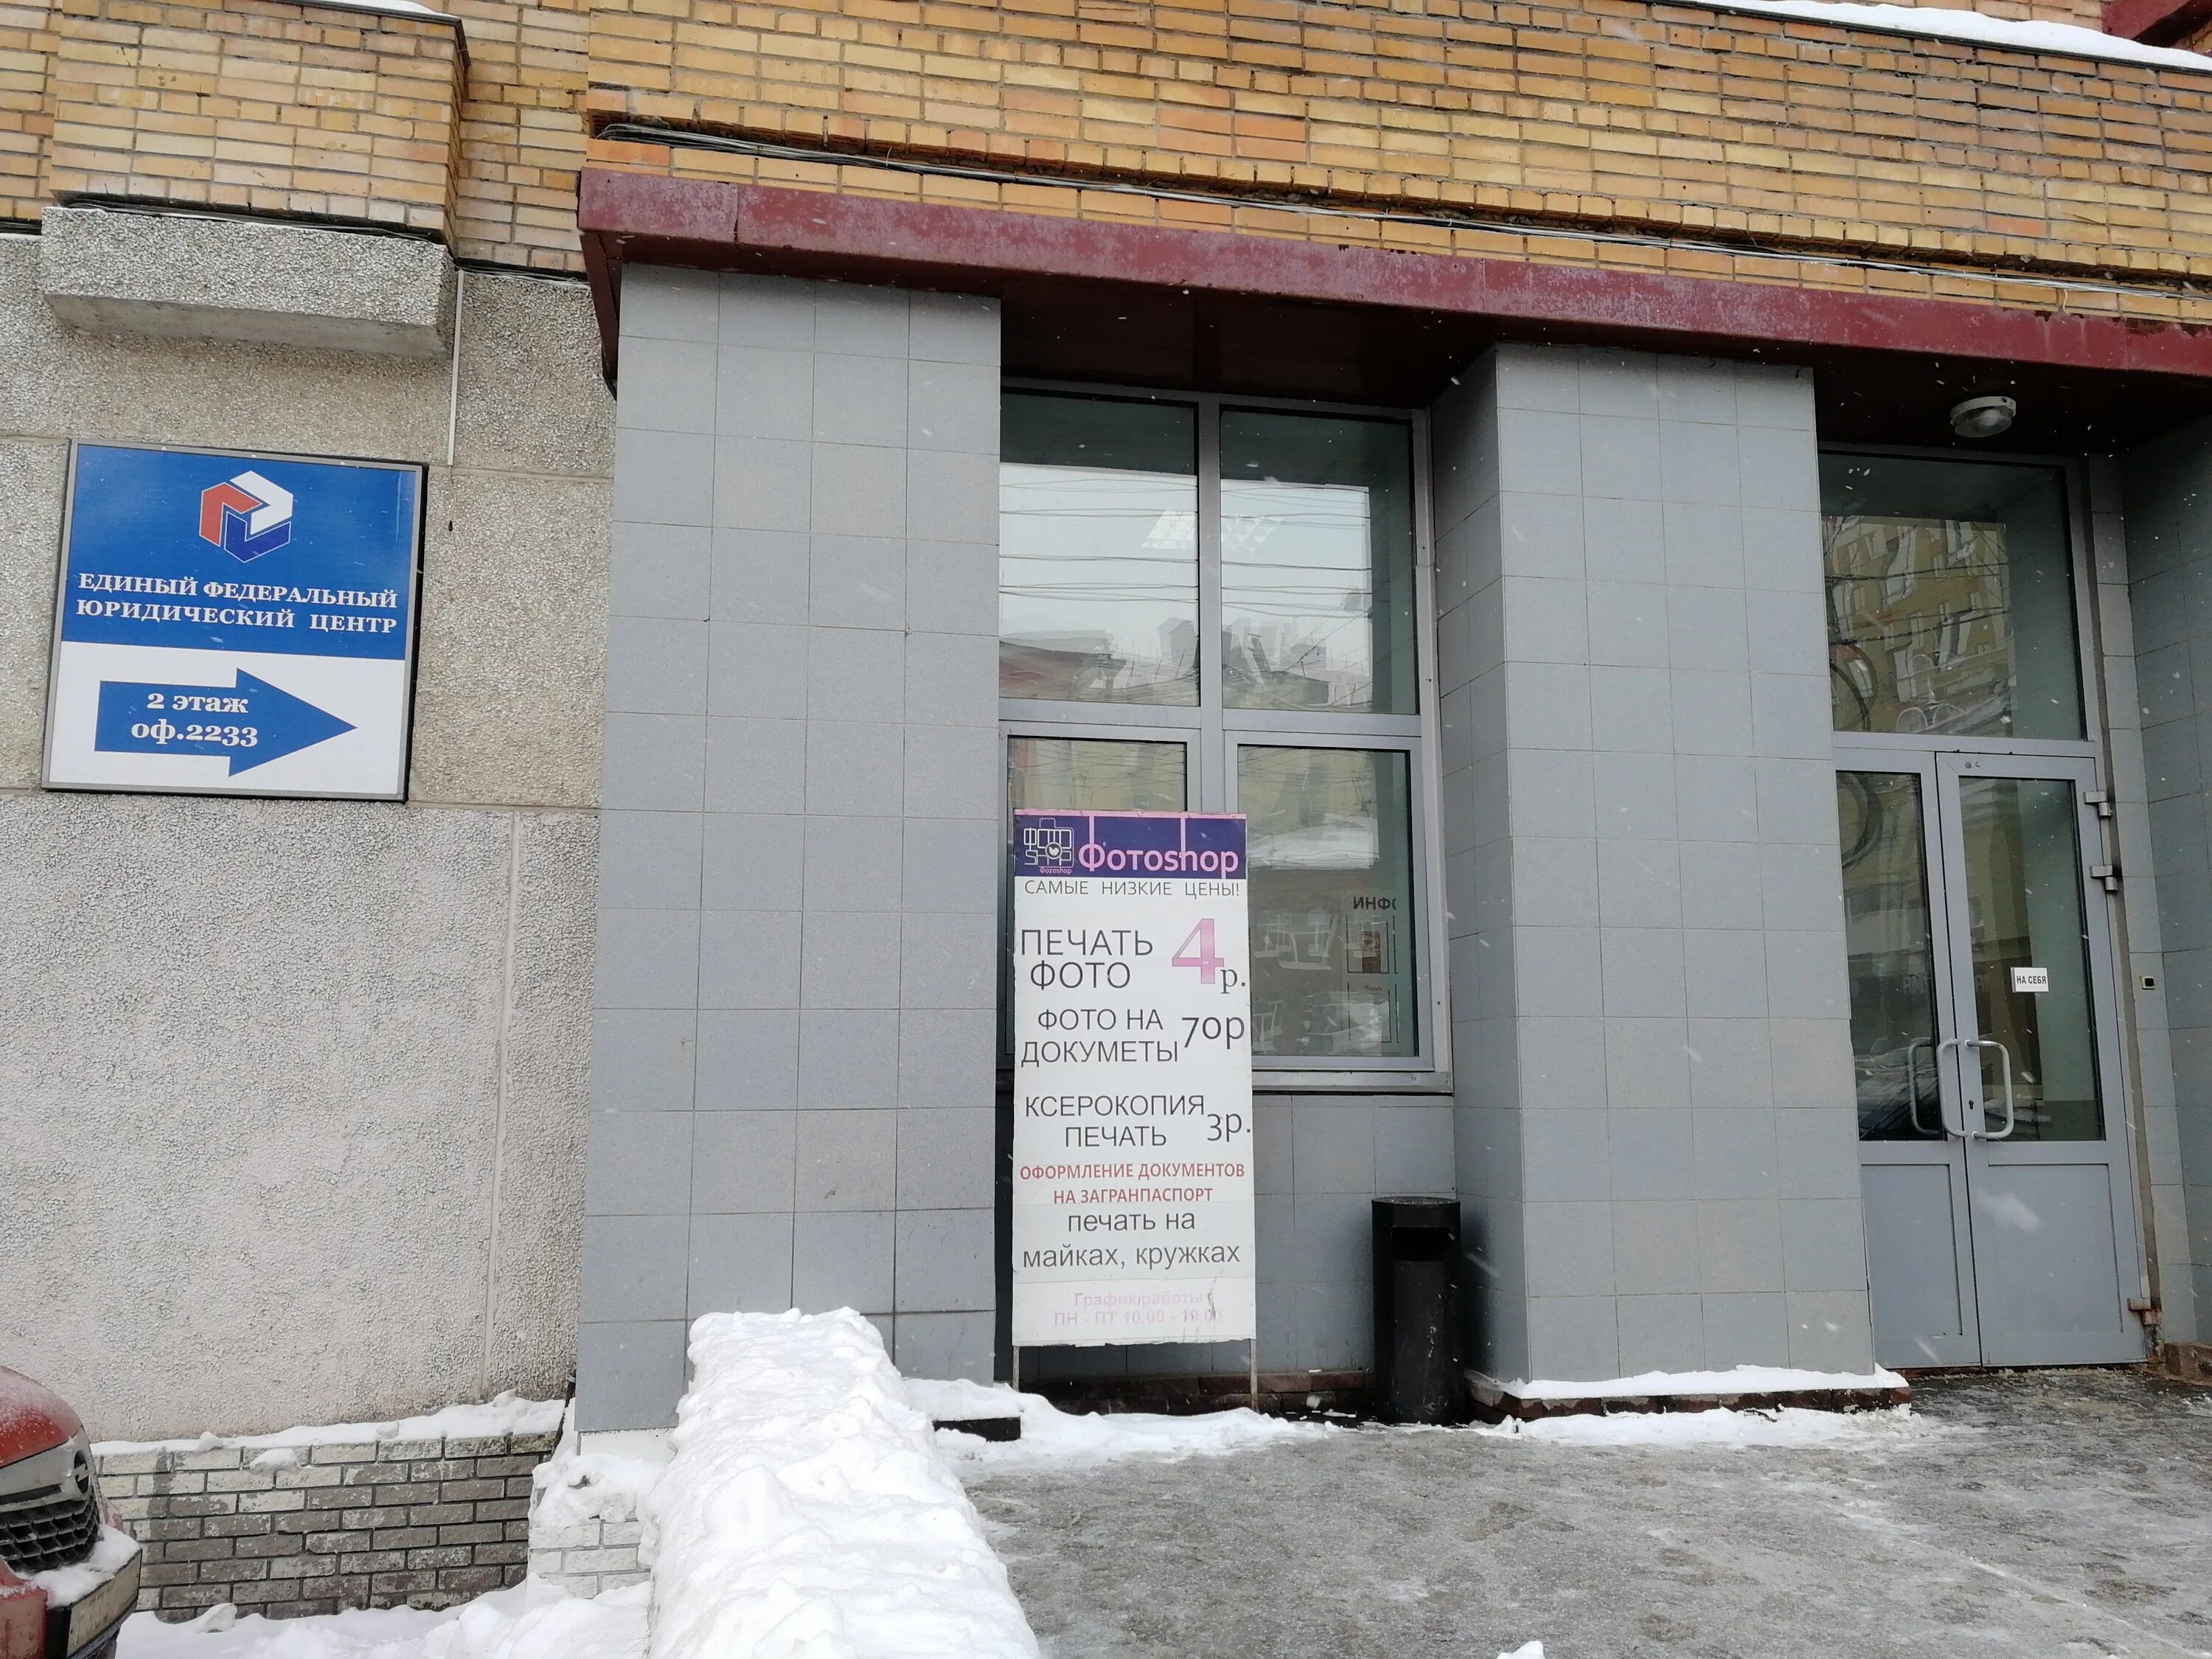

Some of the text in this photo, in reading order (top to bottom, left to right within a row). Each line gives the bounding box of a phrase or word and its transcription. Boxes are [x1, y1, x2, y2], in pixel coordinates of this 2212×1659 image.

[77, 572, 397, 608] ЕДИНЫЙ ФЕДЕРАЛЬНЫЙ
[75, 599, 397, 633] ЮРИДИЧЕСКИЙ ЦЕНТР
[147, 693, 249, 714] 2 этаж
[131, 718, 258, 747] оф.2233
[1024, 880, 1239, 900] САМЫЕ НИЗКИЕ ЦЕНЫ!
[1020, 928, 1153, 956] ПЕЧАТЬ
[1030, 959, 1131, 990] ФОТО
[2017, 975, 2047, 984] НА СЕБЯ
[1037, 1008, 1164, 1031] ФОТО НА
[1020, 1040, 1178, 1068] ДОКУМЕТЫ
[1025, 1095, 1205, 1117] КСЕРОКОПИЯ
[1065, 1125, 1167, 1147] ПЕЧАТЬ
[1020, 1163, 1245, 1180] ОФОРМЛЕНИЕ ДОКУМЕНТОВ
[1054, 1188, 1213, 1204] НА ЗАГРАНПАСПОРТ
[1068, 1212, 1196, 1232] печать на
[1023, 1244, 1241, 1270] майках, кружках
[1054, 1312, 1078, 1326] ПН
[1095, 1311, 1117, 1325] ПТ
